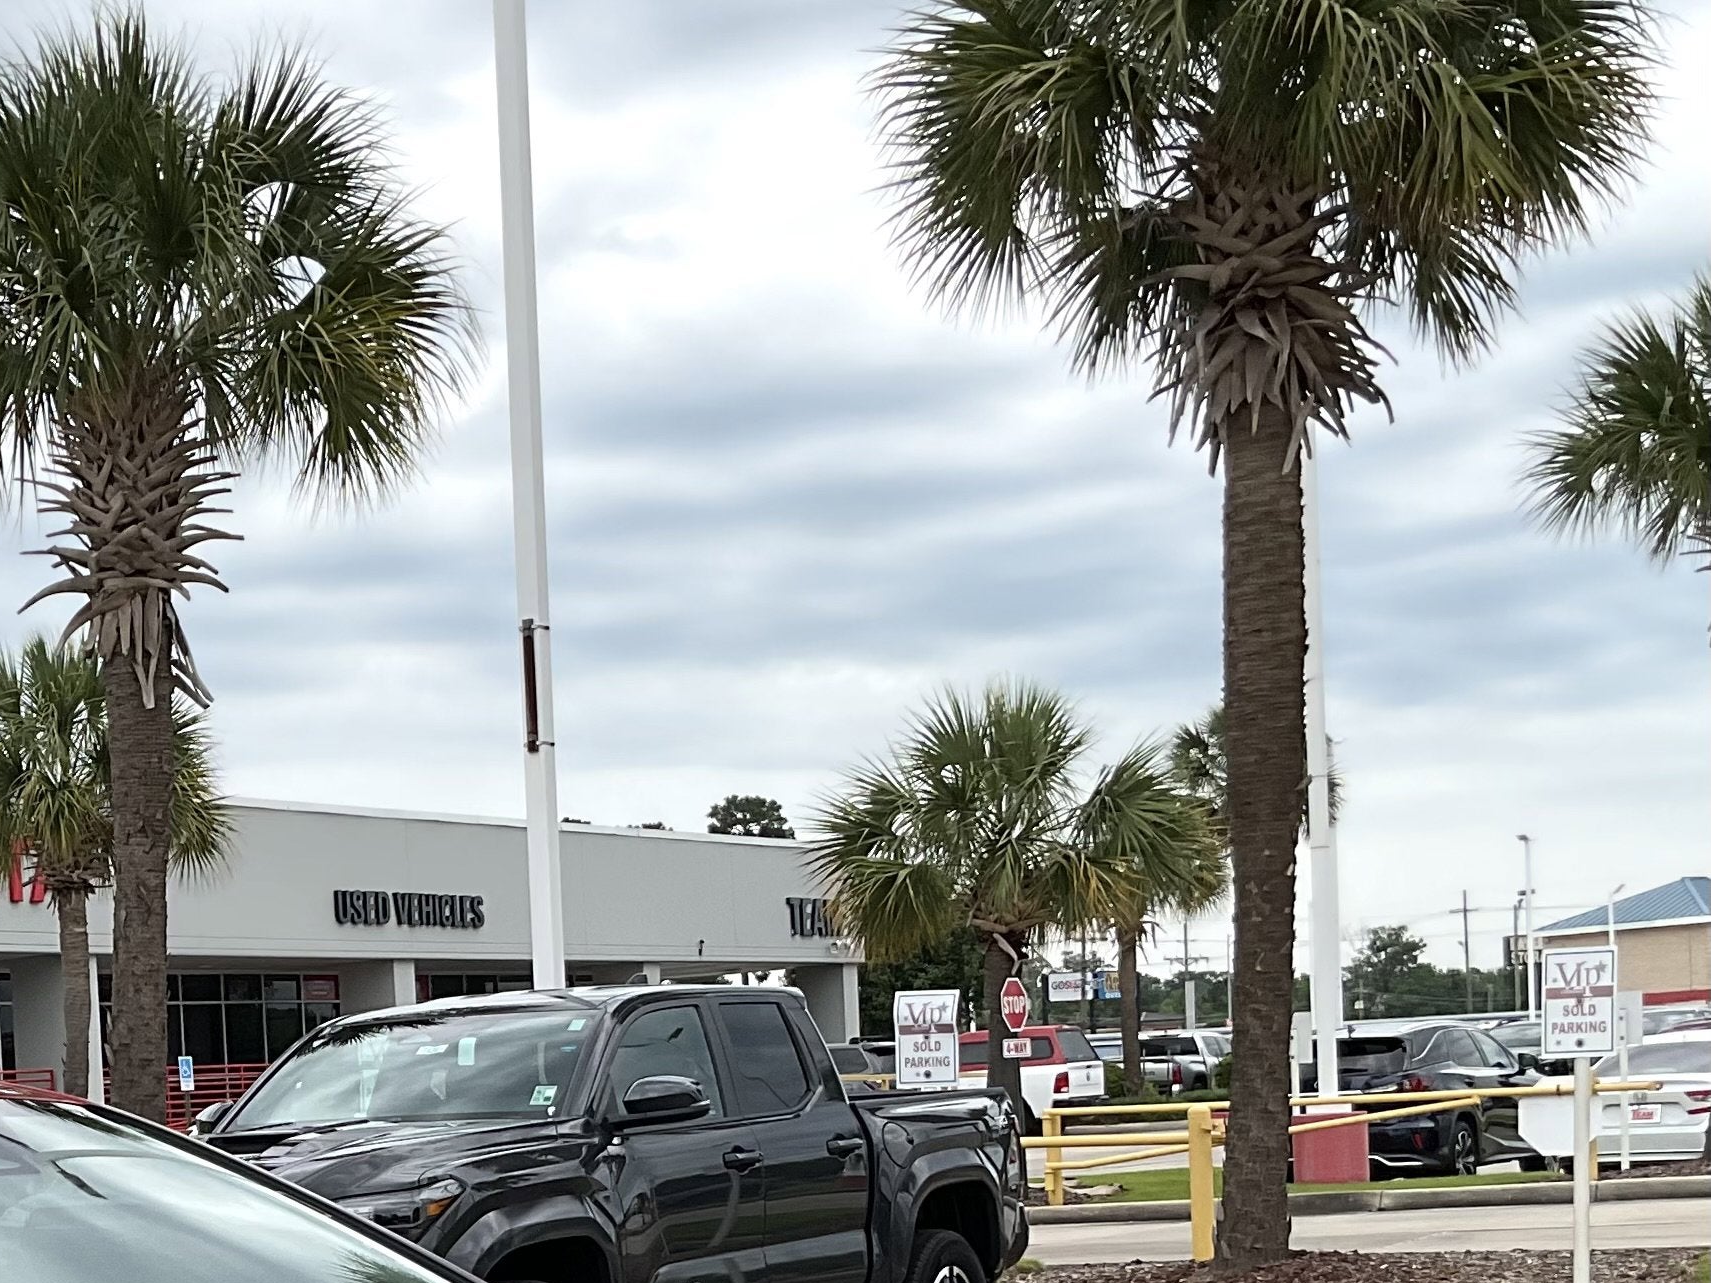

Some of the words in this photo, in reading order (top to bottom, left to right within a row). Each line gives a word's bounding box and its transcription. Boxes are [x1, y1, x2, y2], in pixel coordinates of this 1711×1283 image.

[333, 890, 390, 926] USED
[392, 892, 485, 929] VEHICLES
[1003, 995, 1025, 1014] STOP
[1562, 1004, 1596, 1017] SOLD
[1551, 1021, 1607, 1035] PARKING
[913, 1041, 941, 1053] SOLD
[1006, 1041, 1028, 1054] 4-WAY
[904, 1056, 951, 1068] PARKING
